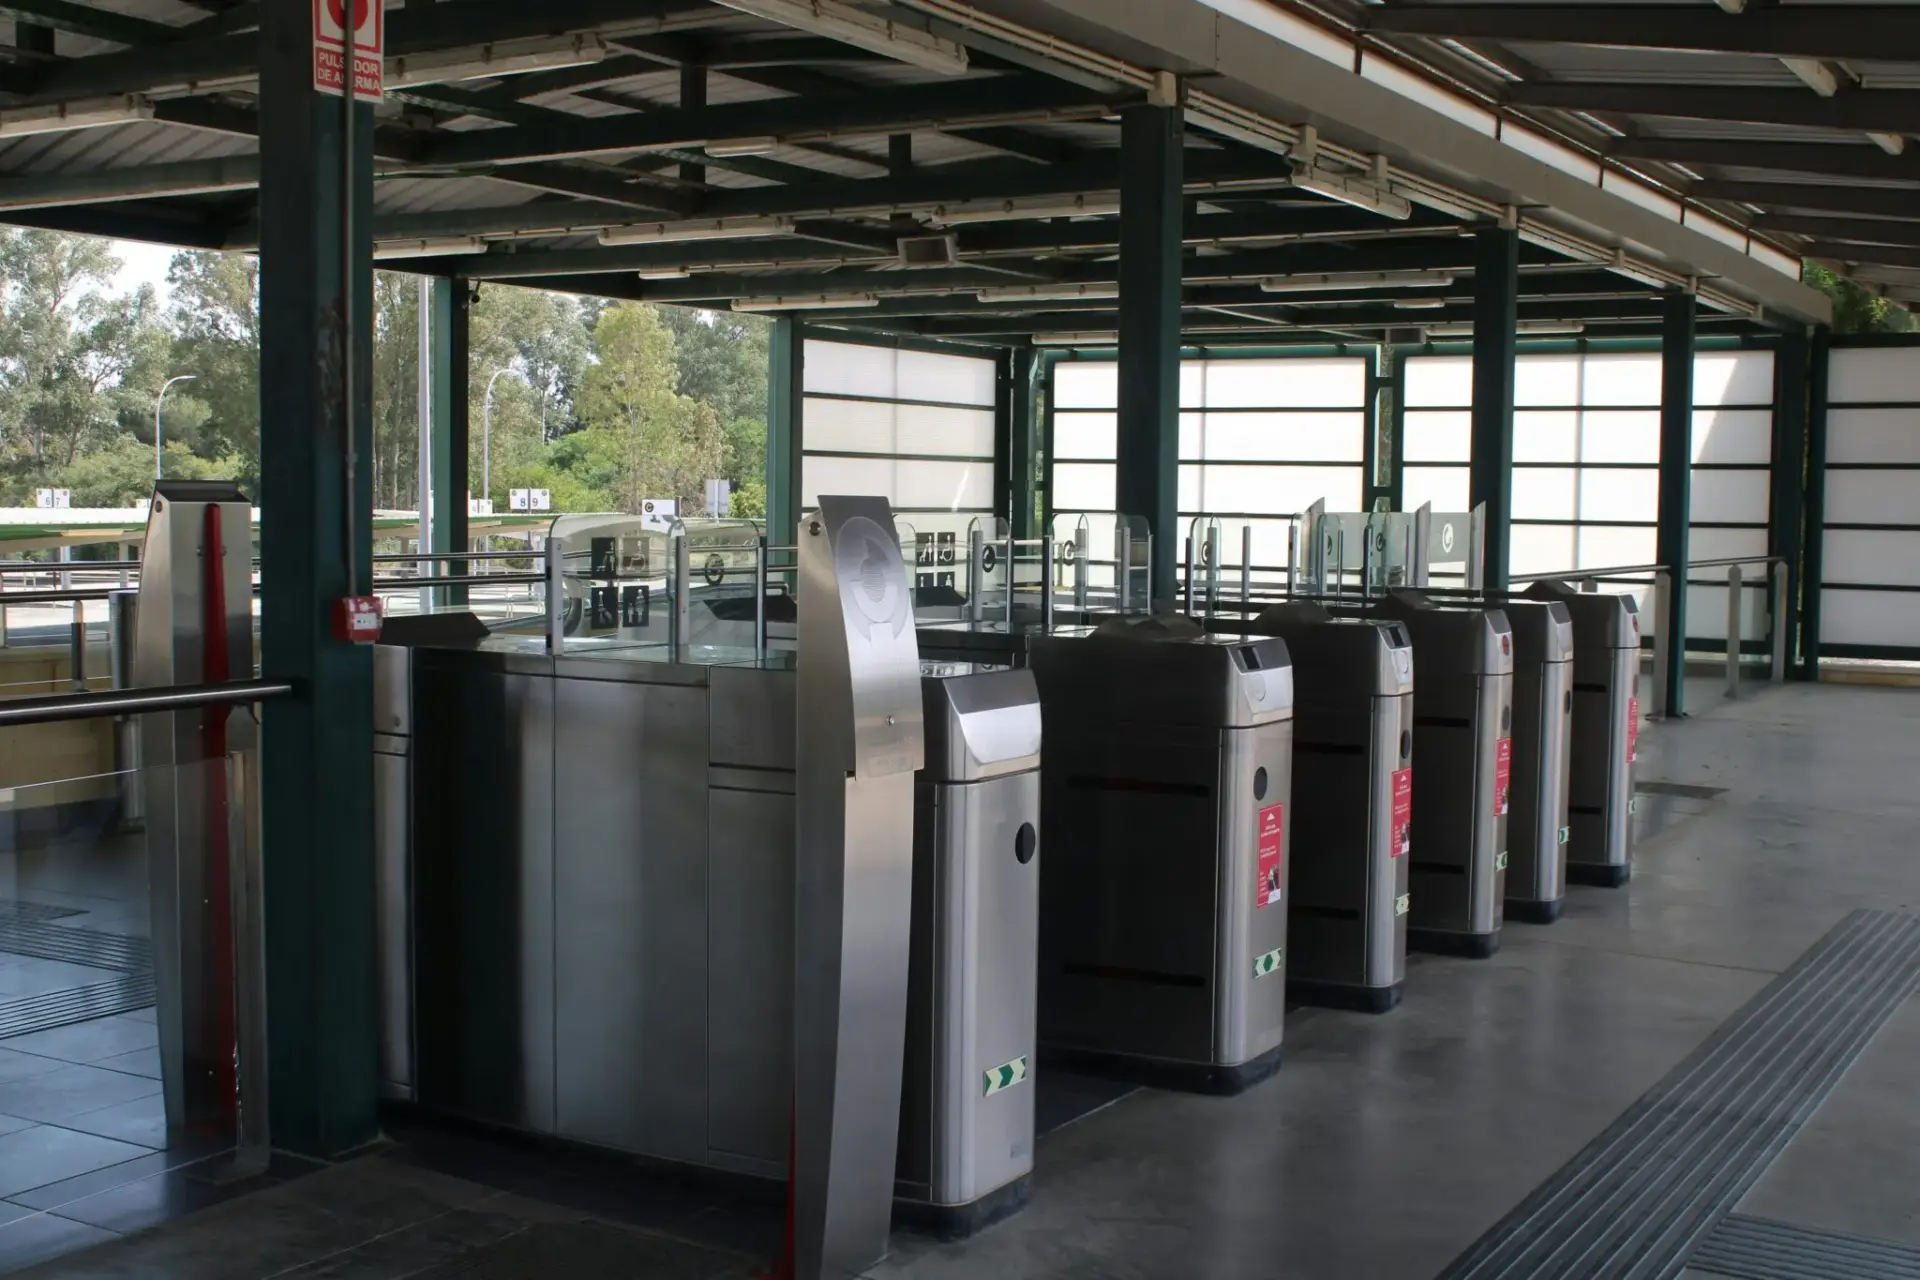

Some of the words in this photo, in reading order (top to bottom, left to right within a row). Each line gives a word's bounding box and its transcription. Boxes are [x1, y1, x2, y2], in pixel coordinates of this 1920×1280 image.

[319, 52, 379, 76] PULSDOR
[318, 67, 332, 81] DE
[520, 498, 526, 507] 8
[532, 498, 539, 507] 9
